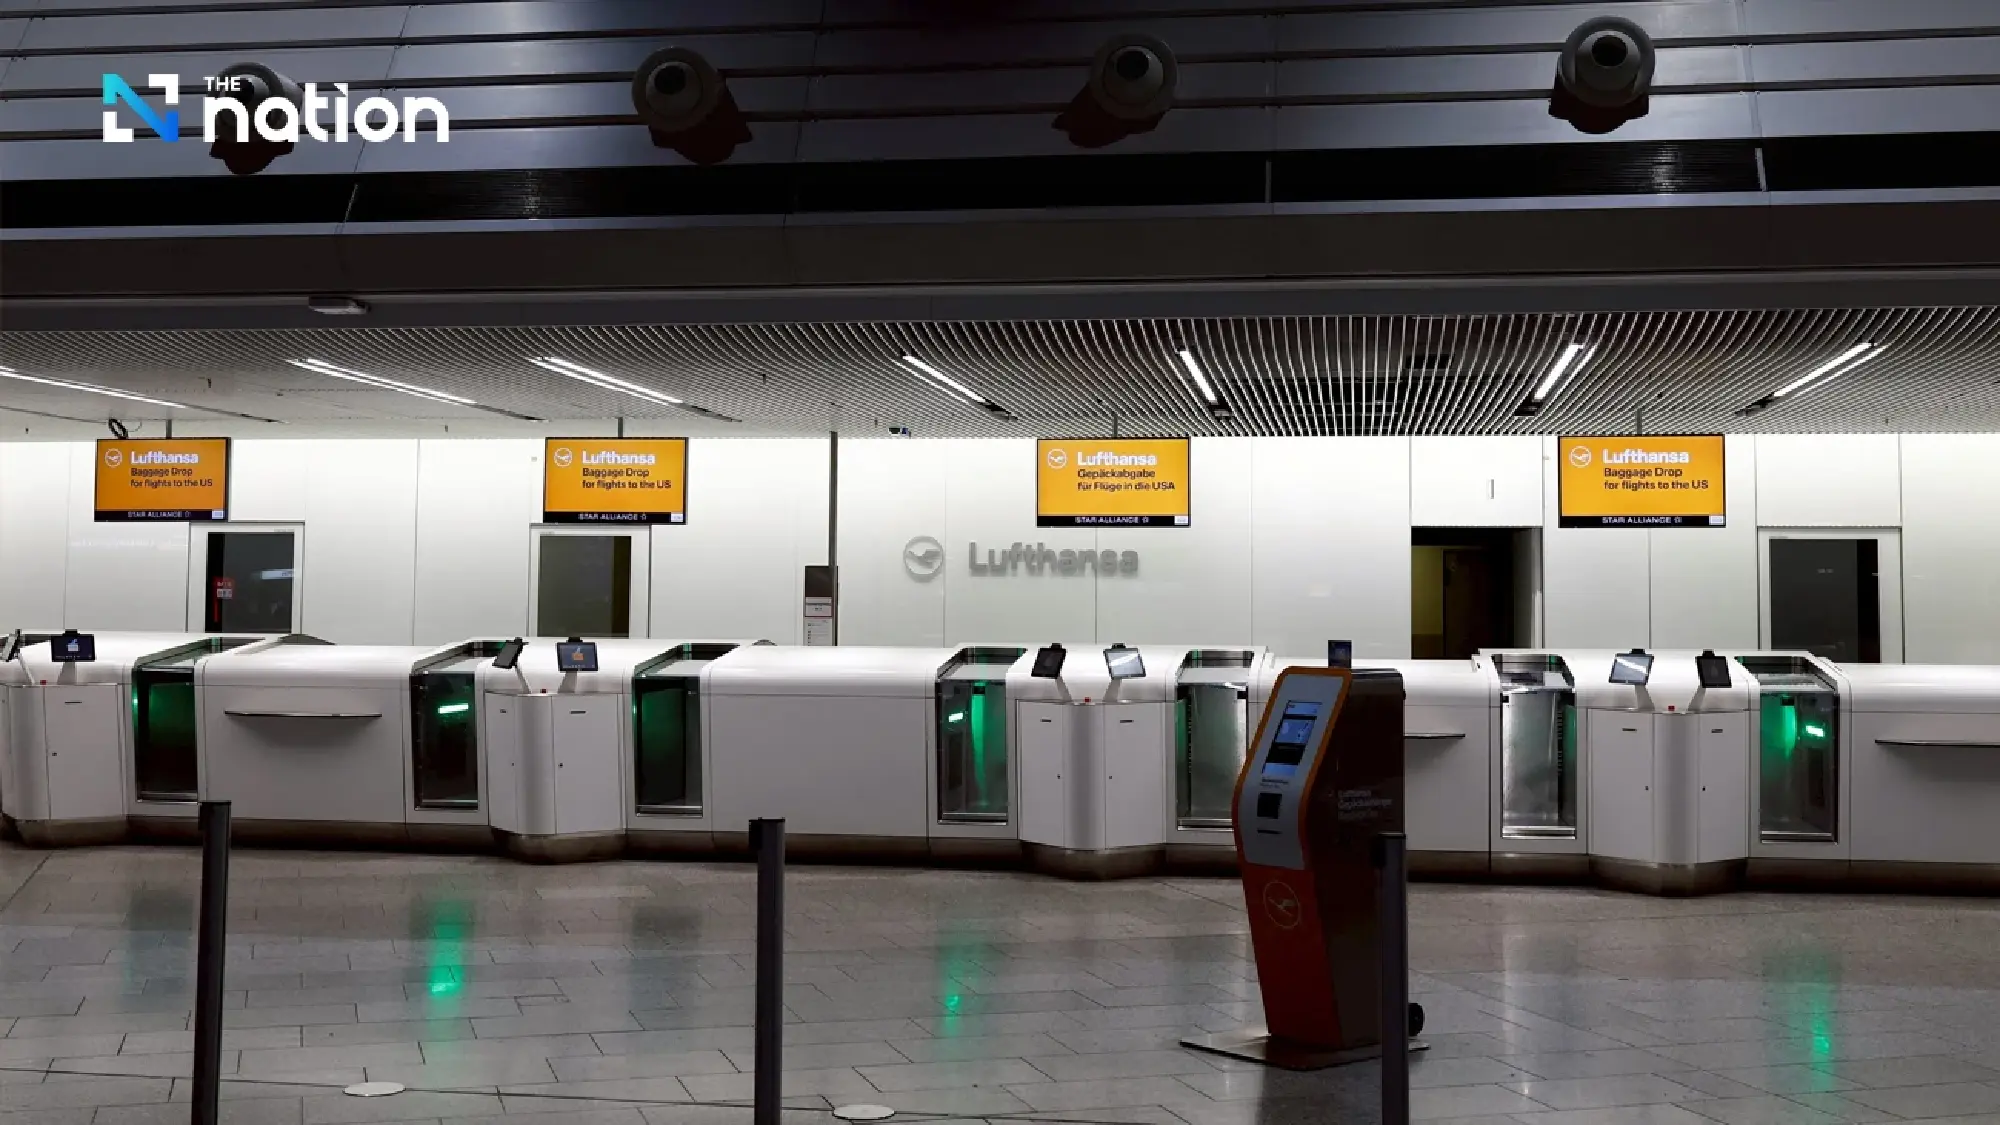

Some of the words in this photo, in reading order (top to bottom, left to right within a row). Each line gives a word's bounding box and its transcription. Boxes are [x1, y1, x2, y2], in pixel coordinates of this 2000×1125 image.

[130, 451, 199, 464] Lufthansa
[582, 450, 656, 465] Lufthansa
[1077, 451, 1157, 466] Lufthansa
[1602, 448, 1690, 464] Lufthansa
[130, 467, 169, 477] Baggage
[171, 467, 193, 477] Drop
[582, 467, 624, 478] Baggage
[625, 467, 650, 478] Drop
[1077, 468, 1156, 480] Gepäckabgabe
[1604, 467, 1653, 479] Baggage
[1654, 467, 1683, 478] Drop
[130, 479, 142, 487] for
[144, 479, 171, 489] flights
[173, 479, 182, 487] to
[184, 479, 198, 487] the
[199, 479, 213, 487] US
[582, 480, 595, 489] for
[597, 480, 627, 491] flights
[628, 480, 638, 489] to
[640, 480, 656, 489] the
[657, 480, 672, 489] US
[1077, 481, 1092, 490] für
[1093, 481, 1123, 492] Flüge
[1124, 482, 1133, 490] in
[1134, 481, 1151, 490] die
[1152, 481, 1176, 490] USA
[1604, 480, 1619, 489] for
[1621, 480, 1656, 491] flights
[1657, 480, 1670, 489] to
[1671, 480, 1690, 489] the
[1691, 480, 1709, 489] US
[968, 541, 1140, 576] Lufthansa
